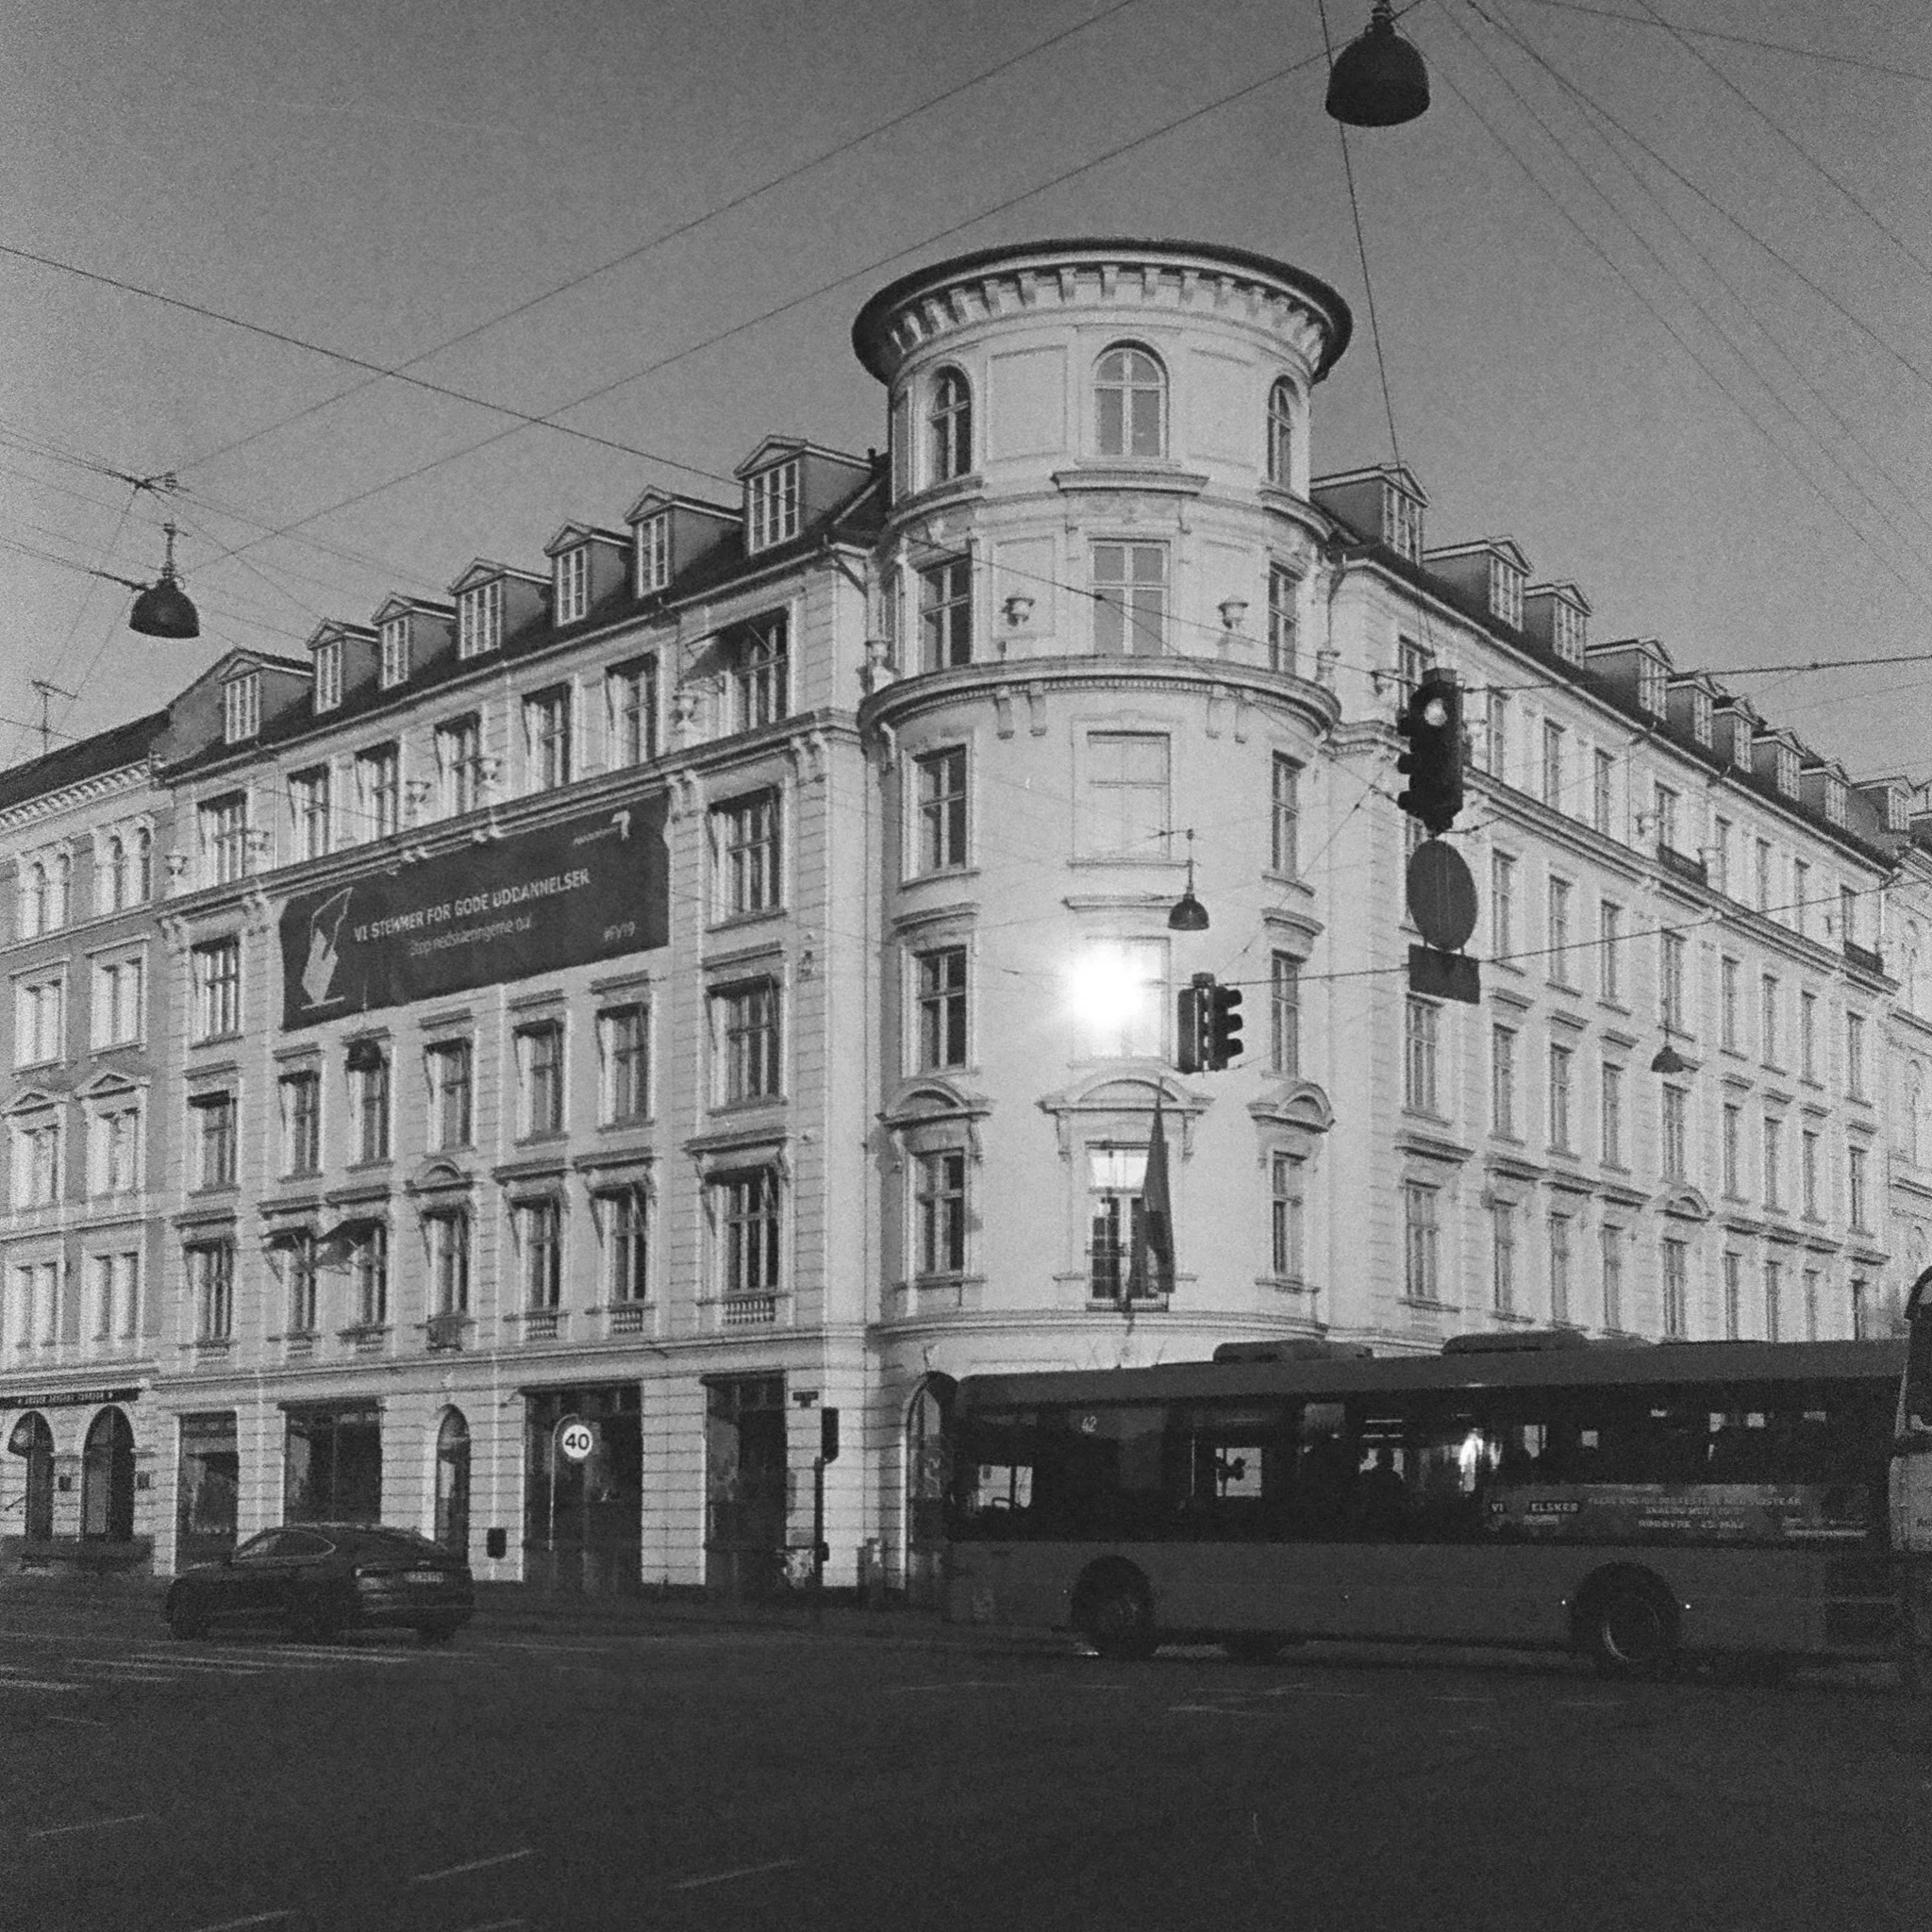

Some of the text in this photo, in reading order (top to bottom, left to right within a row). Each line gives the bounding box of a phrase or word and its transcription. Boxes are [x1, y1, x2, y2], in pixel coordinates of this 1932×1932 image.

[354, 868, 590, 941] VI STEMMER FOR GODE UDDANNELSER
[565, 1433, 590, 1450] 40
[1491, 1502, 1578, 1512] VI ELSKER
